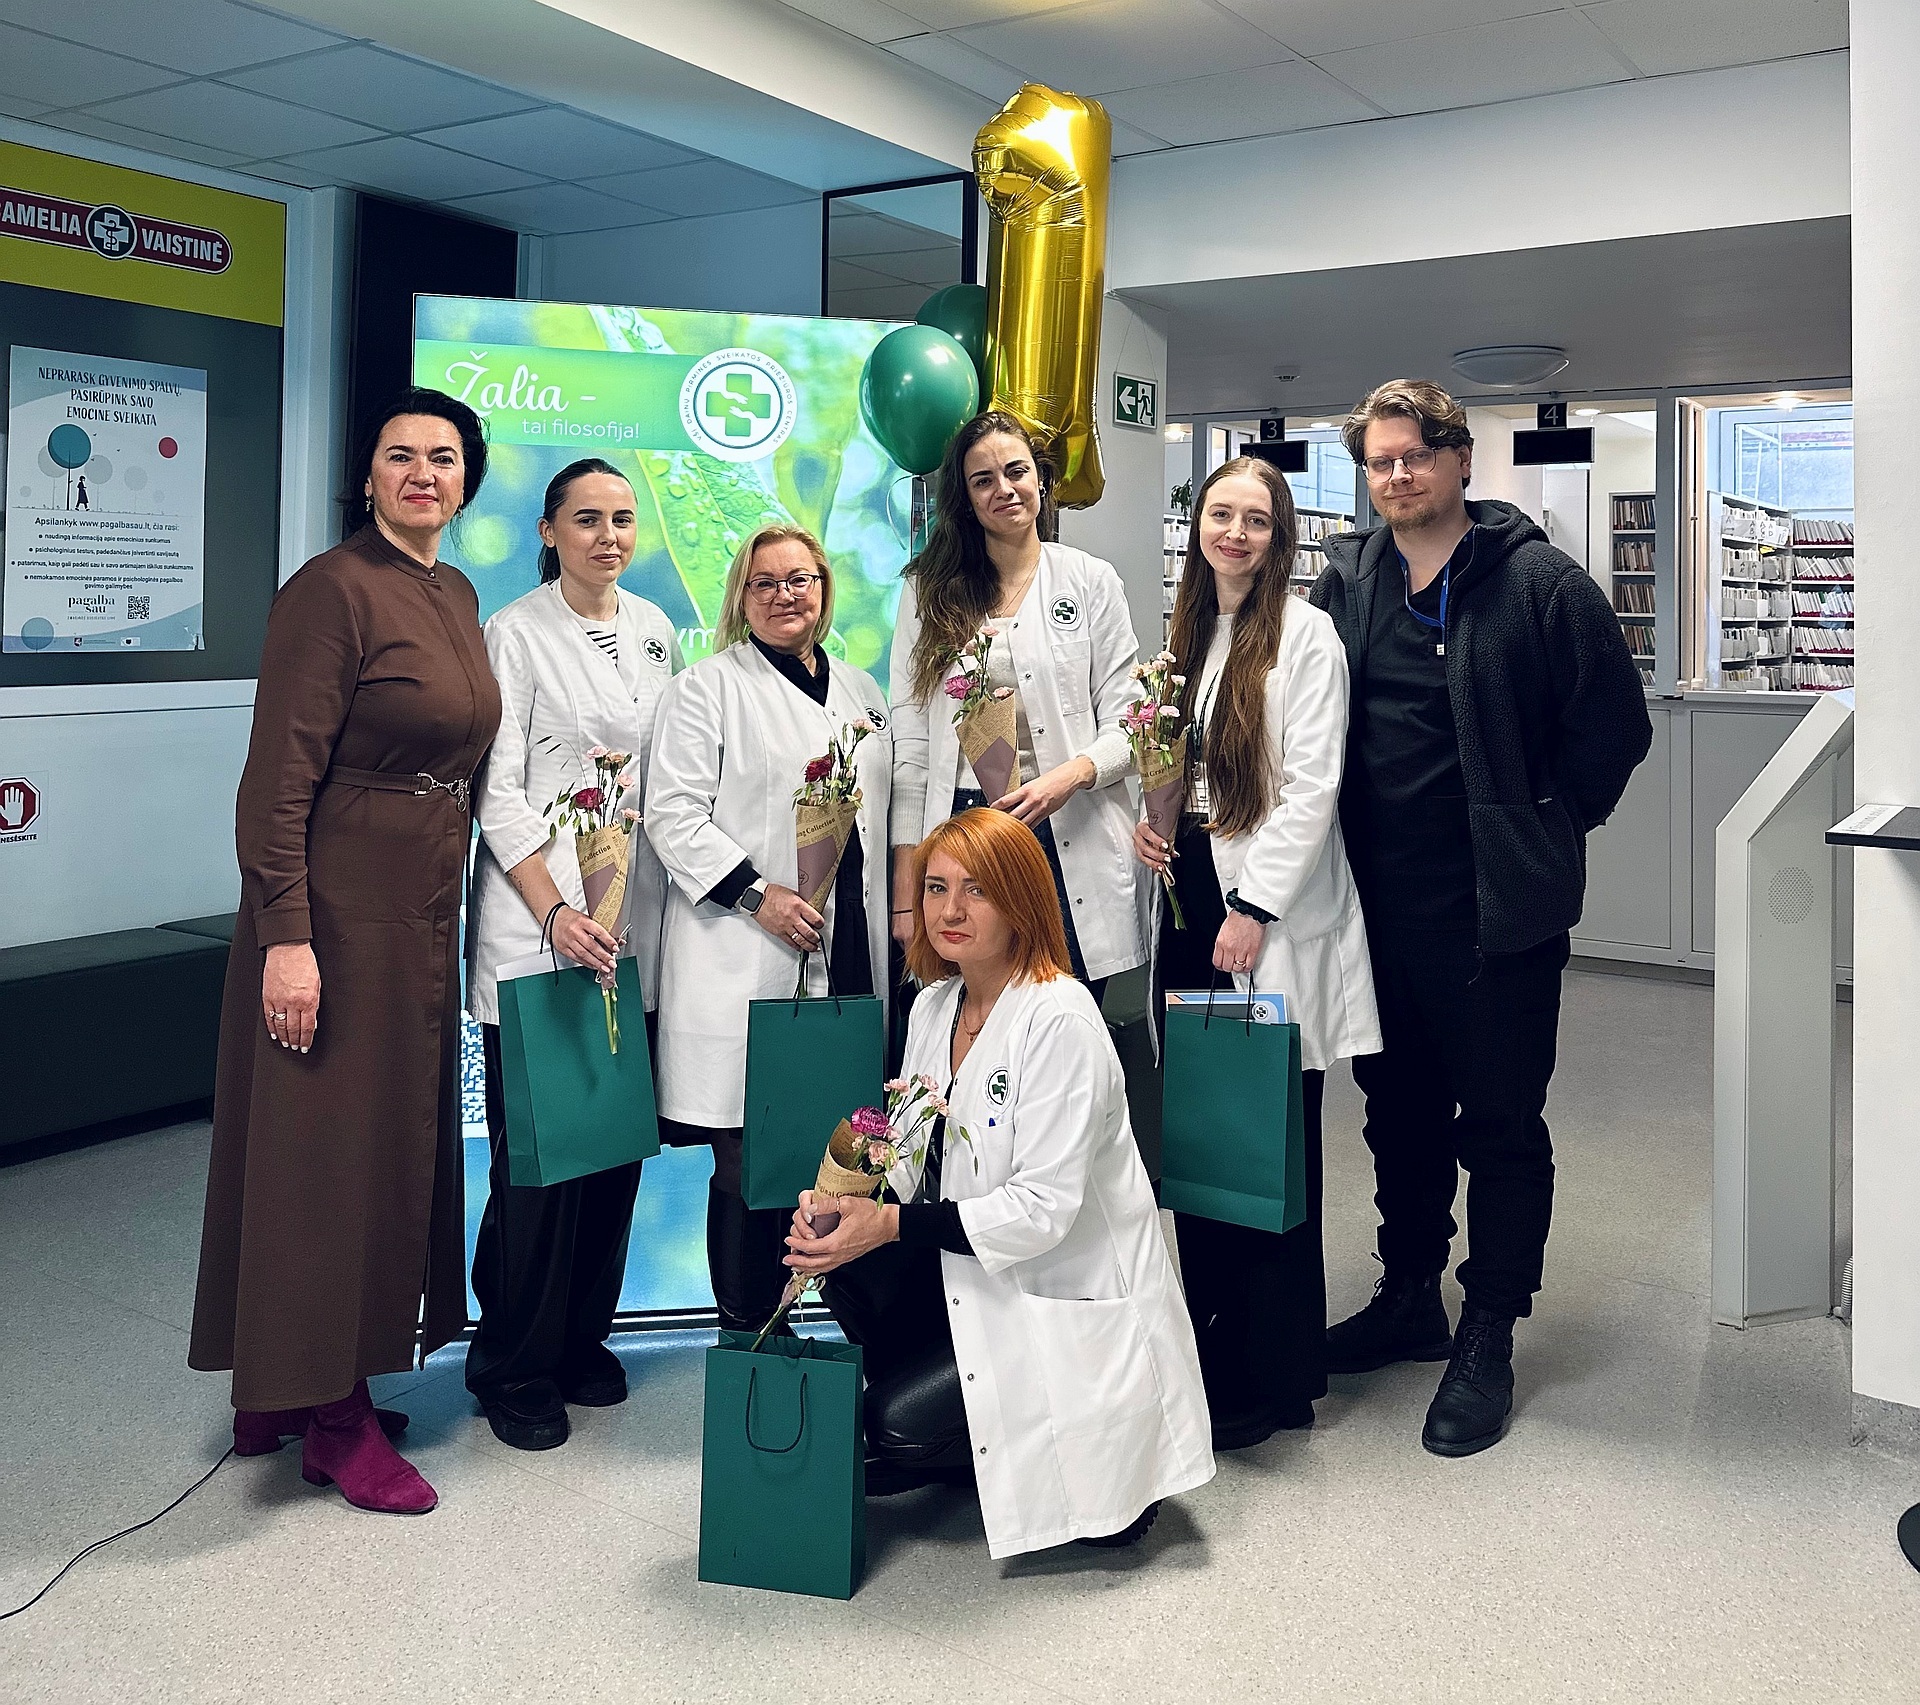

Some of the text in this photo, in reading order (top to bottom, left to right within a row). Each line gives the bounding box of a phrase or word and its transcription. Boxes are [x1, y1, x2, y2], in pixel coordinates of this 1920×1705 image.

[0, 201, 222, 263] AMELIA VAISTINĖ
[38, 366, 96, 385] NEPRARASK
[98, 374, 146, 391] GYVENIMO
[445, 350, 569, 417] Žalia
[70, 388, 154, 408] PASIRŪPINK SAVO
[716, 352, 761, 362] SVEIKATOS
[772, 410, 793, 444] CENTRAS
[66, 406, 157, 426] EMOCINE SVEIKATA
[1544, 405, 1558, 426] 4
[522, 418, 640, 442] tai filosofija!
[1266, 420, 1278, 439] 3
[34, 517, 78, 528] Apsilankyk
[68, 594, 115, 608] pagalba
[86, 605, 106, 613] sau
